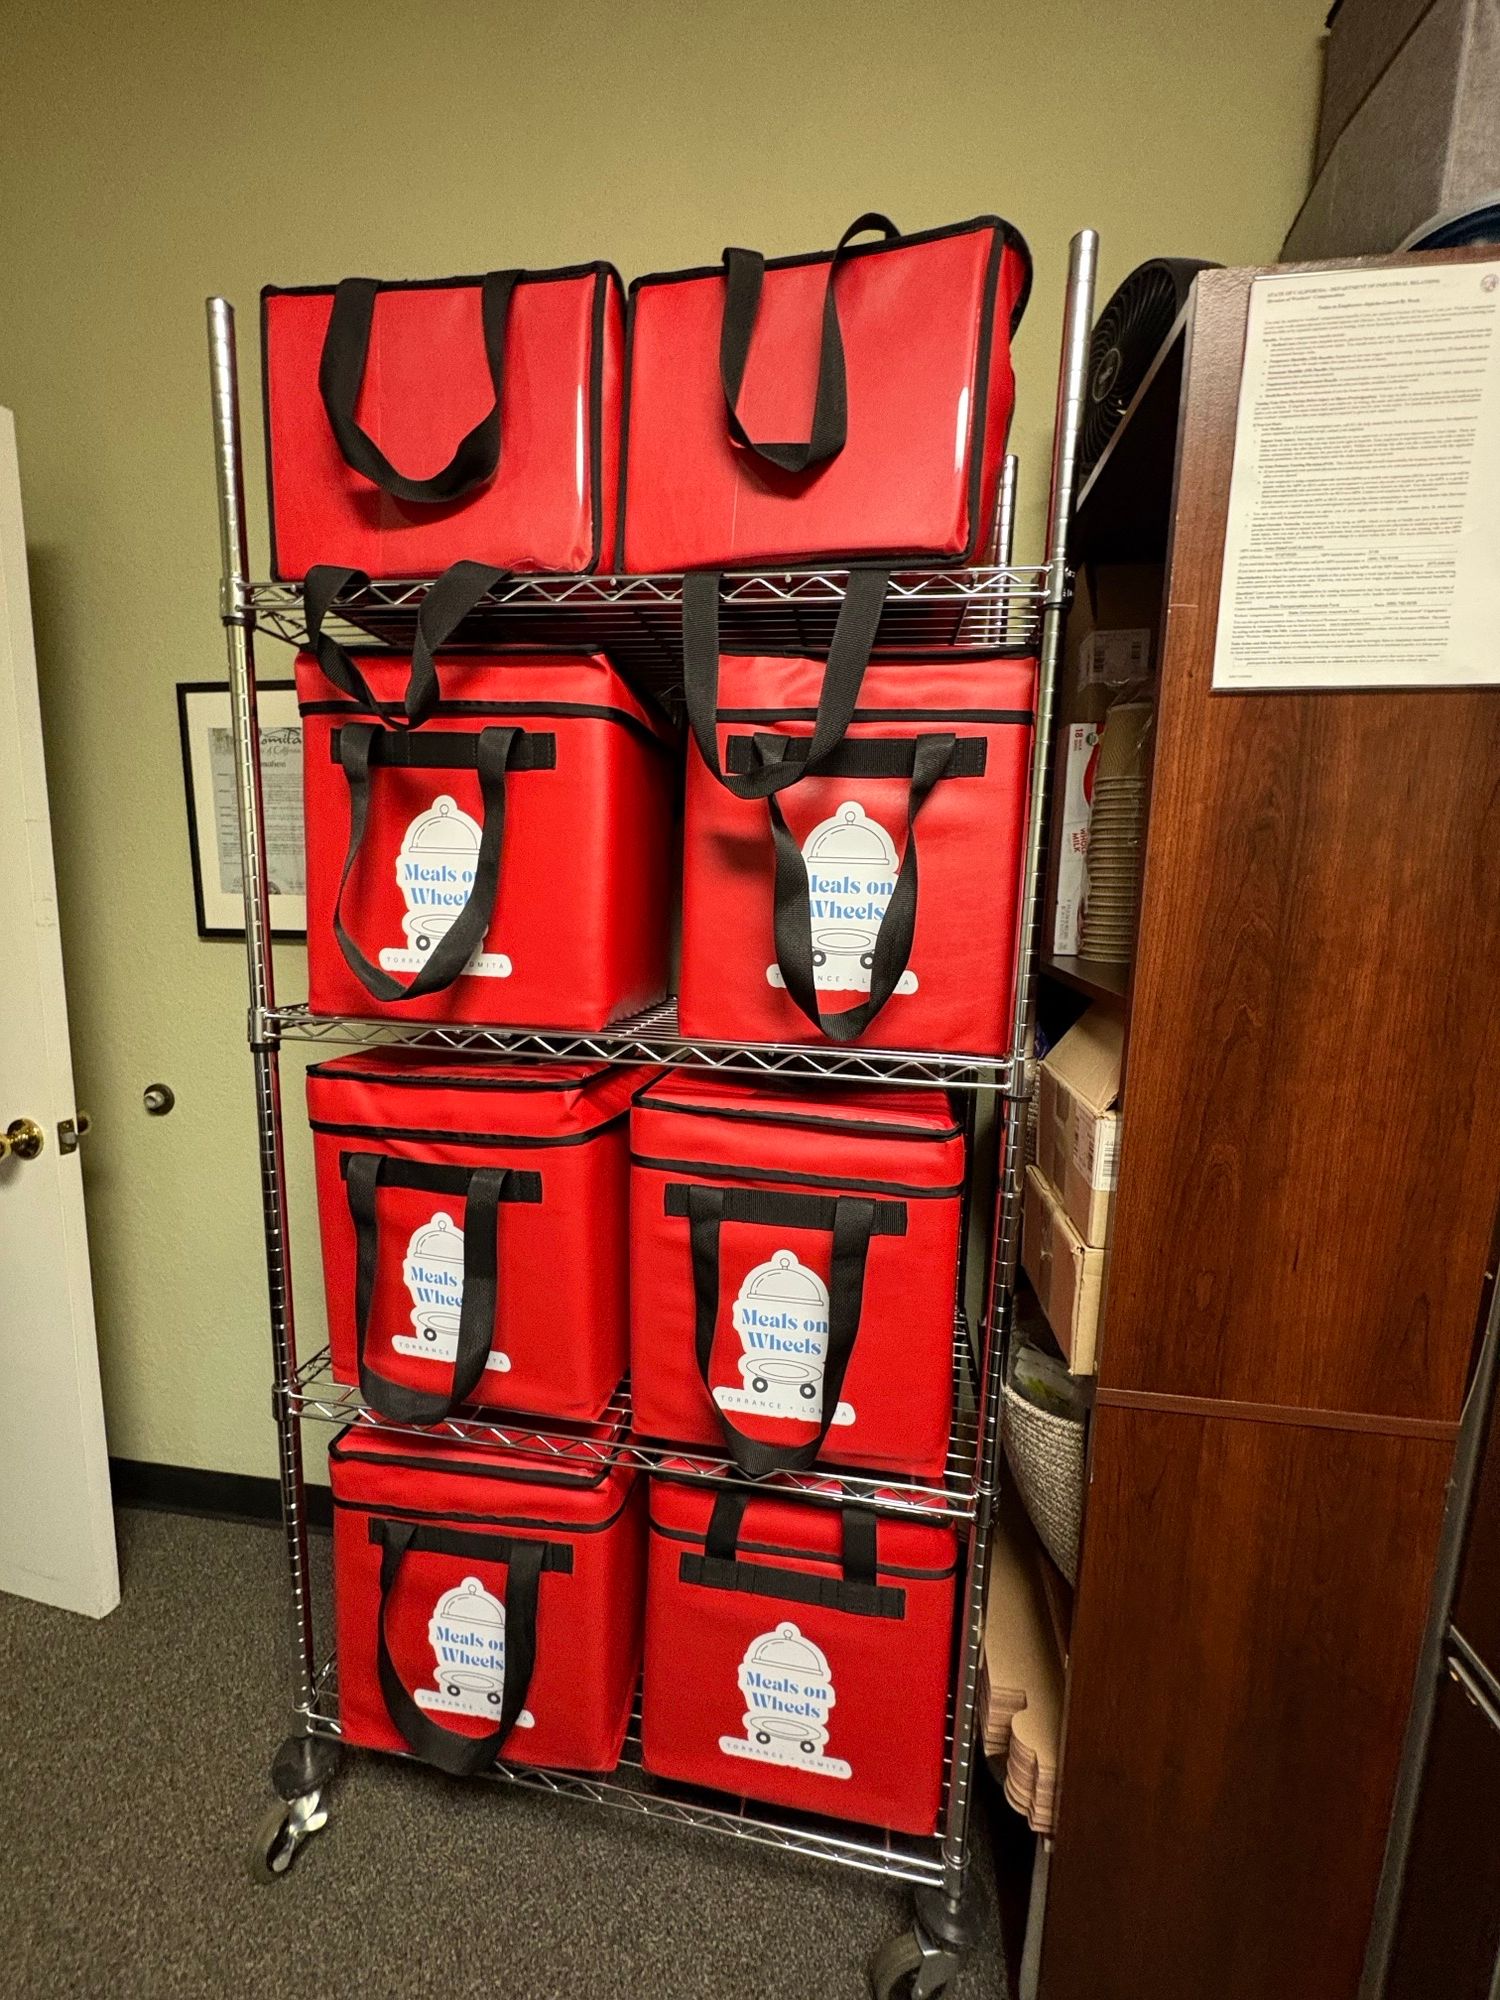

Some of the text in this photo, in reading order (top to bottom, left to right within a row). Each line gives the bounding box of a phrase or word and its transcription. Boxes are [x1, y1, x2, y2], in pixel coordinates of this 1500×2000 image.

[1075, 729, 1083, 738] 18
[1072, 832, 1080, 853] MILK
[404, 863, 477, 882] Meals o
[411, 887, 471, 906] Wheel
[866, 880, 894, 895] on
[810, 900, 884, 920] Wheels
[386, 956, 427, 965] TORRA
[469, 961, 504, 969] OMITA
[774, 972, 840, 983] TNCE
[411, 1266, 457, 1287] Meals
[416, 1287, 462, 1308] Whee
[742, 1308, 828, 1334] Meals on
[398, 1342, 450, 1356] TORRANCE
[748, 1331, 822, 1356] Wheels
[720, 1394, 782, 1409] TORRANCE
[436, 1626, 484, 1648] Meals
[442, 1646, 504, 1671] Wheels
[746, 1671, 828, 1701] Meals on
[752, 1692, 821, 1719] Wheels
[725, 1742, 845, 1772] TORRANCE LOMITA
